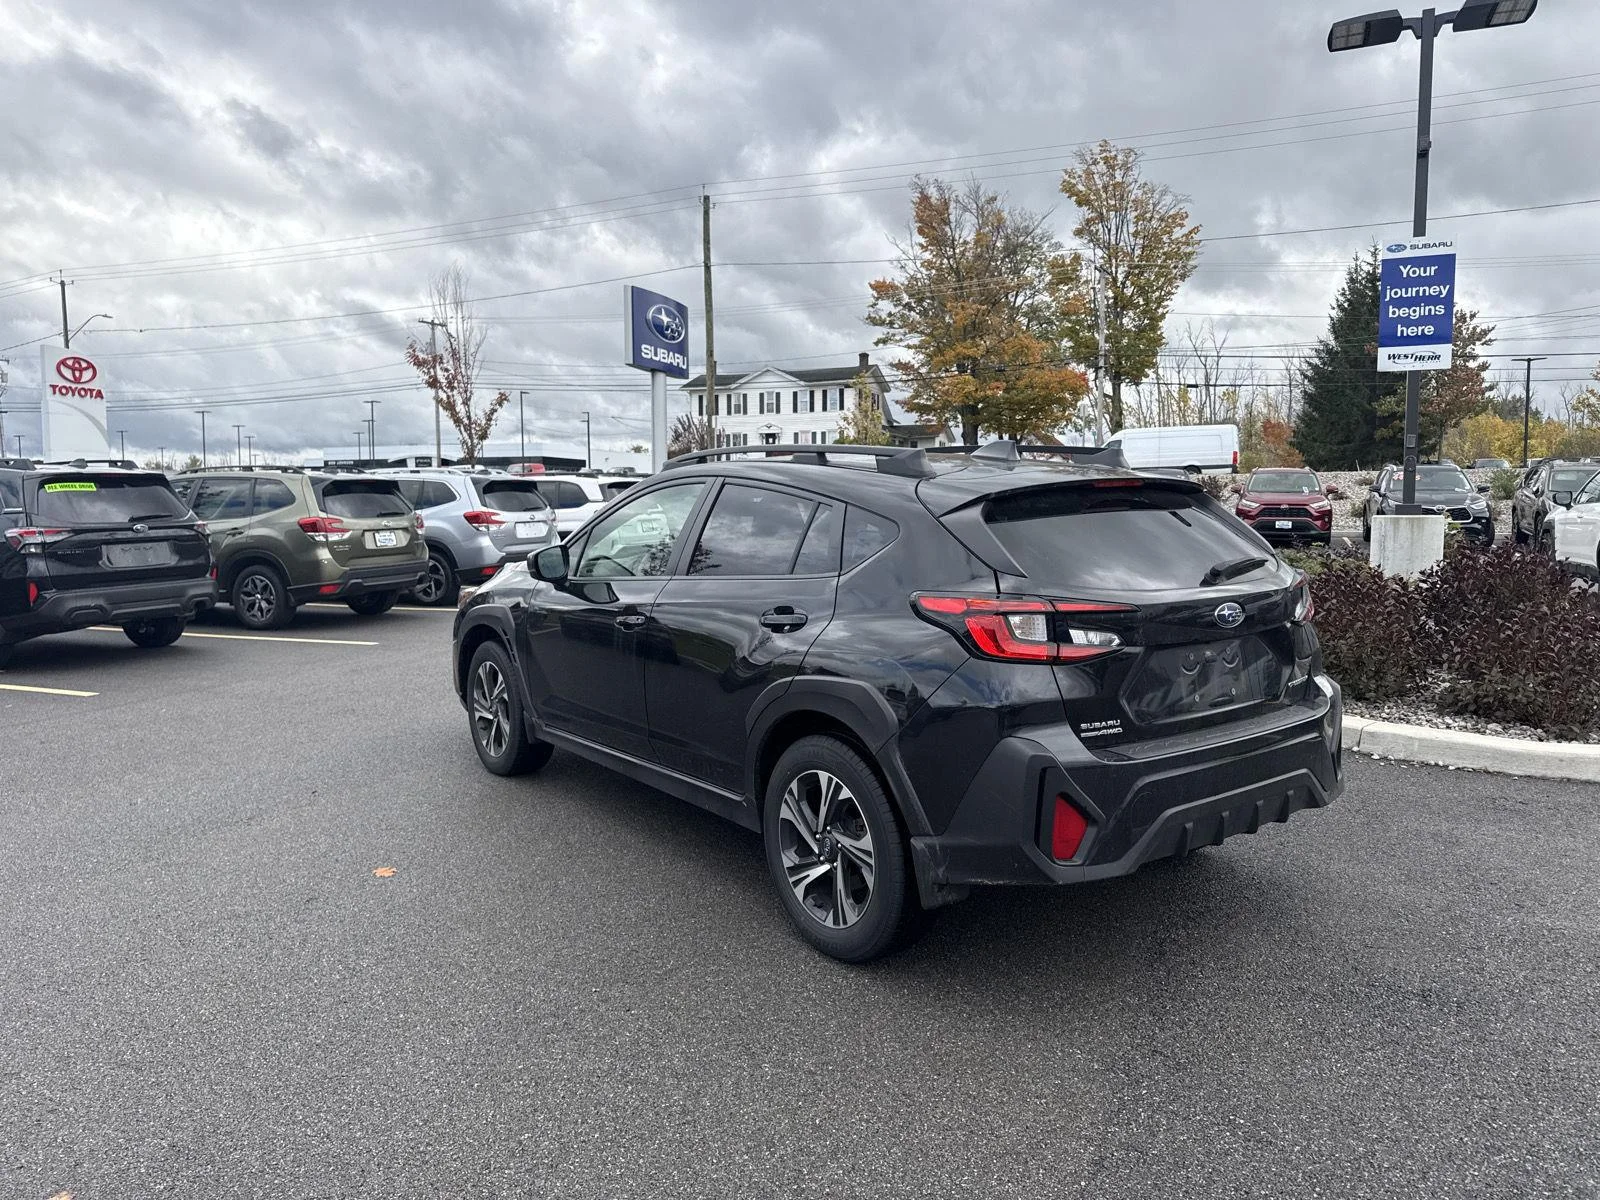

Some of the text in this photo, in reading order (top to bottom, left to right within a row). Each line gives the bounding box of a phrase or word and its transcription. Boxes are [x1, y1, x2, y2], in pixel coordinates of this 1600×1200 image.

[1409, 241, 1453, 250] SUBARU
[1399, 264, 1438, 278] Your
[1385, 284, 1450, 302] journey
[1388, 303, 1445, 319] begins
[1397, 323, 1435, 337] here
[641, 344, 687, 369] SUBARU
[49, 384, 104, 400] TOYOTA
[1080, 719, 1120, 729] SUBARU
